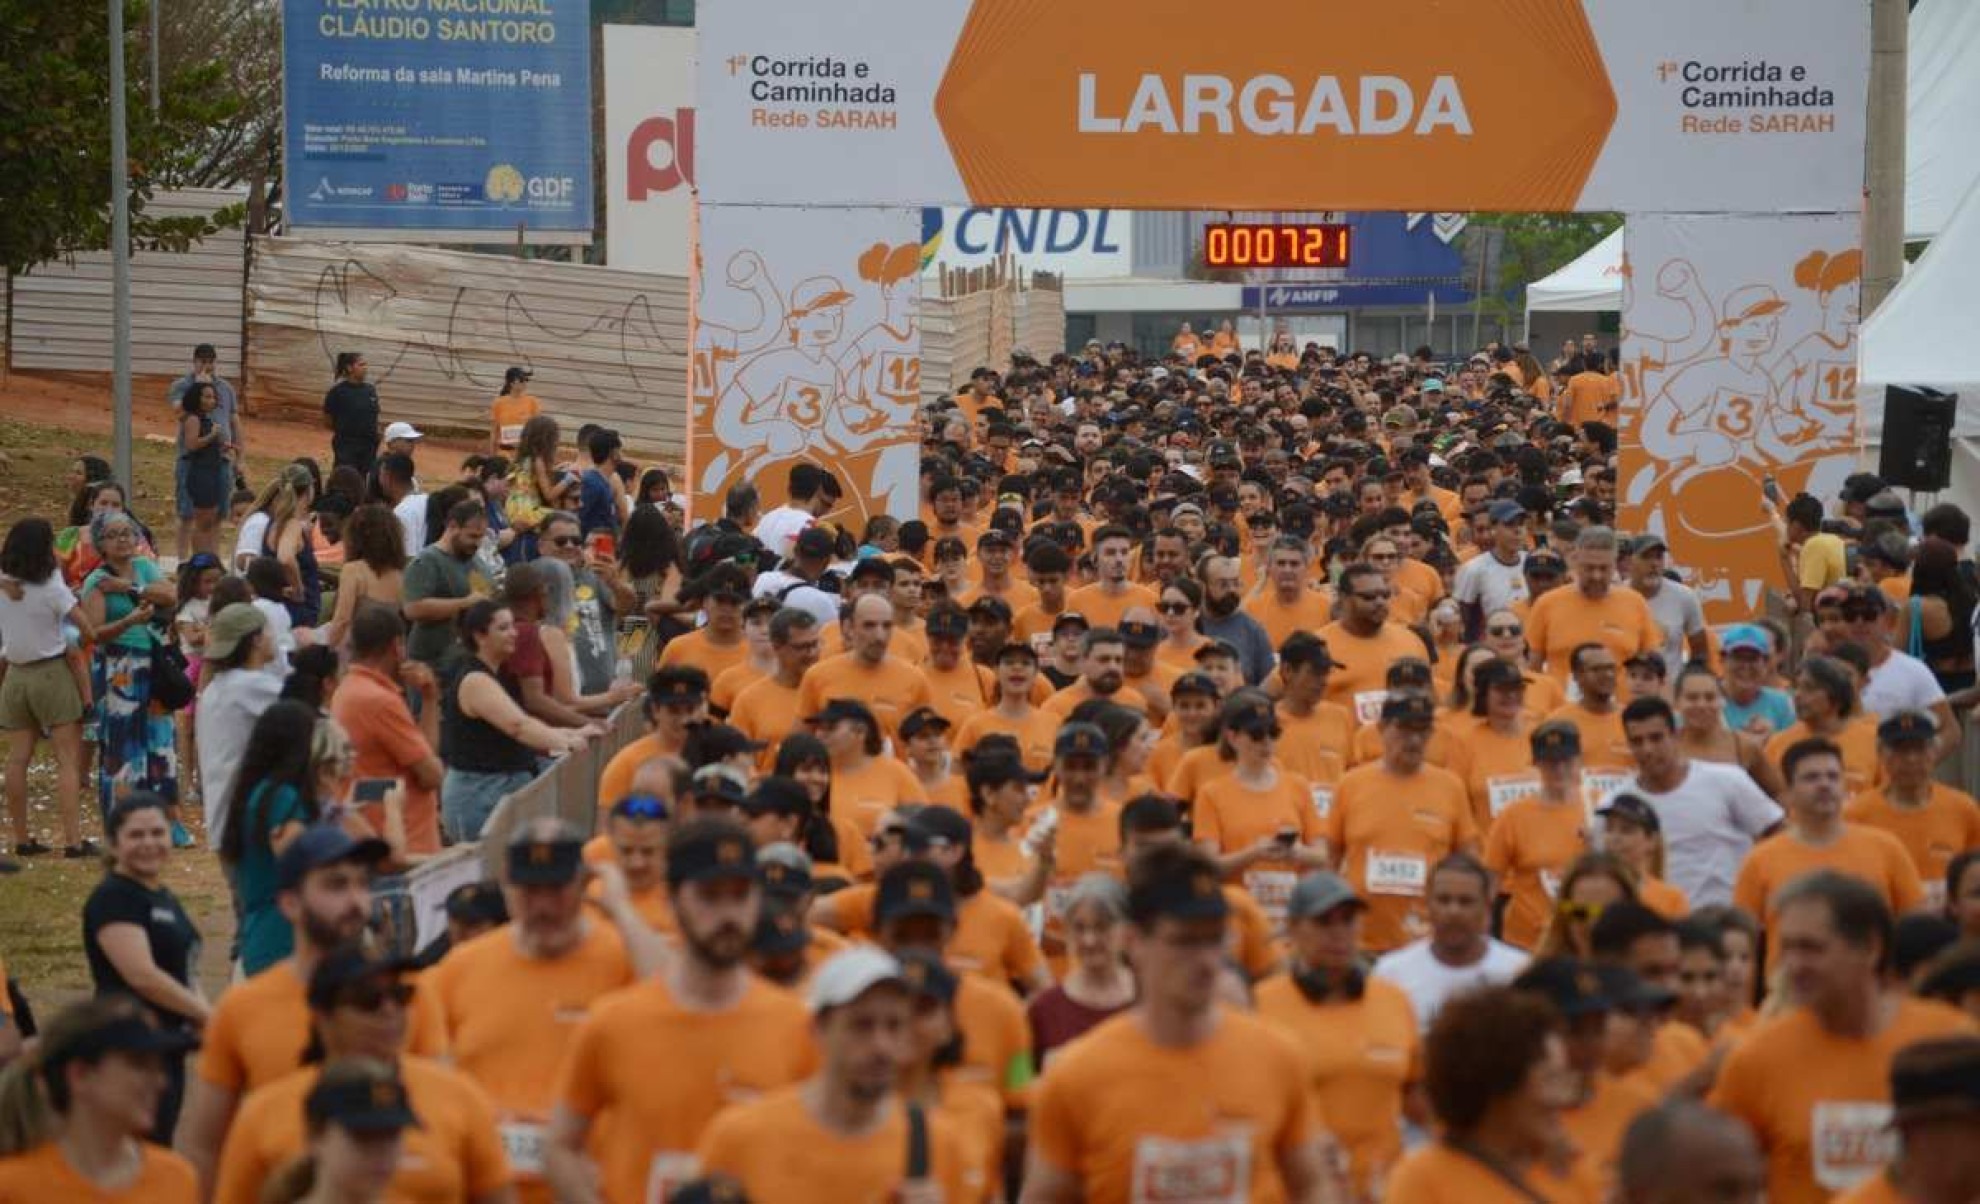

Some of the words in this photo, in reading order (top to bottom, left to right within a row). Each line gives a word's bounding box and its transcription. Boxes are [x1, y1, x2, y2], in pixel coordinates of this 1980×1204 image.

[320, 10, 430, 39] CLÁUDIO
[438, 19, 556, 43] SANTORO
[321, 63, 390, 81] Reforma
[395, 66, 415, 82] da
[419, 67, 452, 83] sala
[456, 68, 516, 85] Martins
[520, 69, 561, 86] Pena
[752, 55, 846, 77] Corrida
[854, 62, 869, 78] e
[1682, 60, 1782, 82] Corrida
[1790, 64, 1807, 82] e
[752, 80, 896, 103] Caminhada
[1682, 85, 1834, 108] Caminhada
[1077, 72, 1474, 136] LARGADA
[752, 108, 809, 128] Rede
[817, 109, 897, 129] SARAH
[1682, 114, 1742, 133] Rede
[1749, 114, 1835, 133] SARAH
[528, 177, 574, 197] GDF
[954, 208, 1120, 255] CNDL
[1208, 228, 1347, 264] 000721
[1291, 289, 1339, 303] ANFIP
[888, 357, 920, 390] 12
[1824, 366, 1857, 399] 12
[787, 387, 821, 425] 3
[1716, 396, 1753, 436] 3
